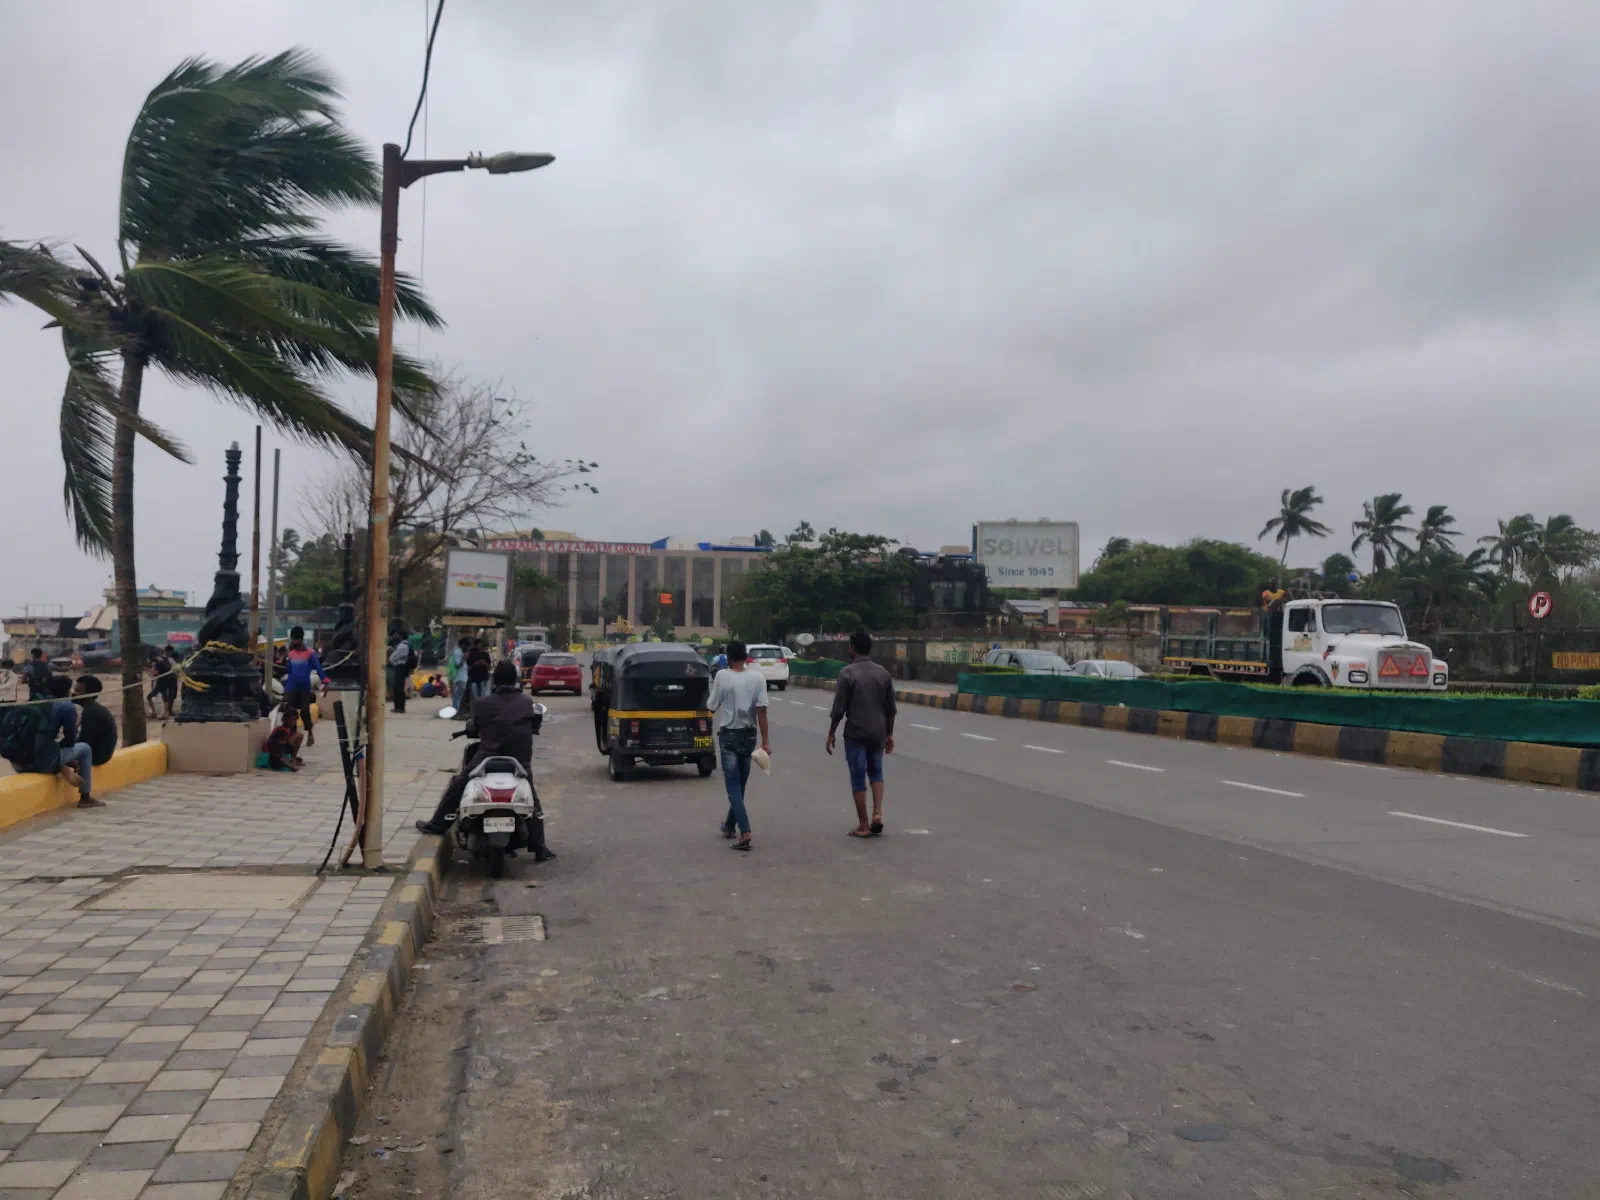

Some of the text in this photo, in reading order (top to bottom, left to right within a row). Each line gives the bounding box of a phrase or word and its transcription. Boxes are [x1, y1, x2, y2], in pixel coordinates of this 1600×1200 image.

[546, 540, 581, 553] PLAZA
[998, 567, 1054, 576] Since 1945
[1571, 655, 1600, 667] PARK
